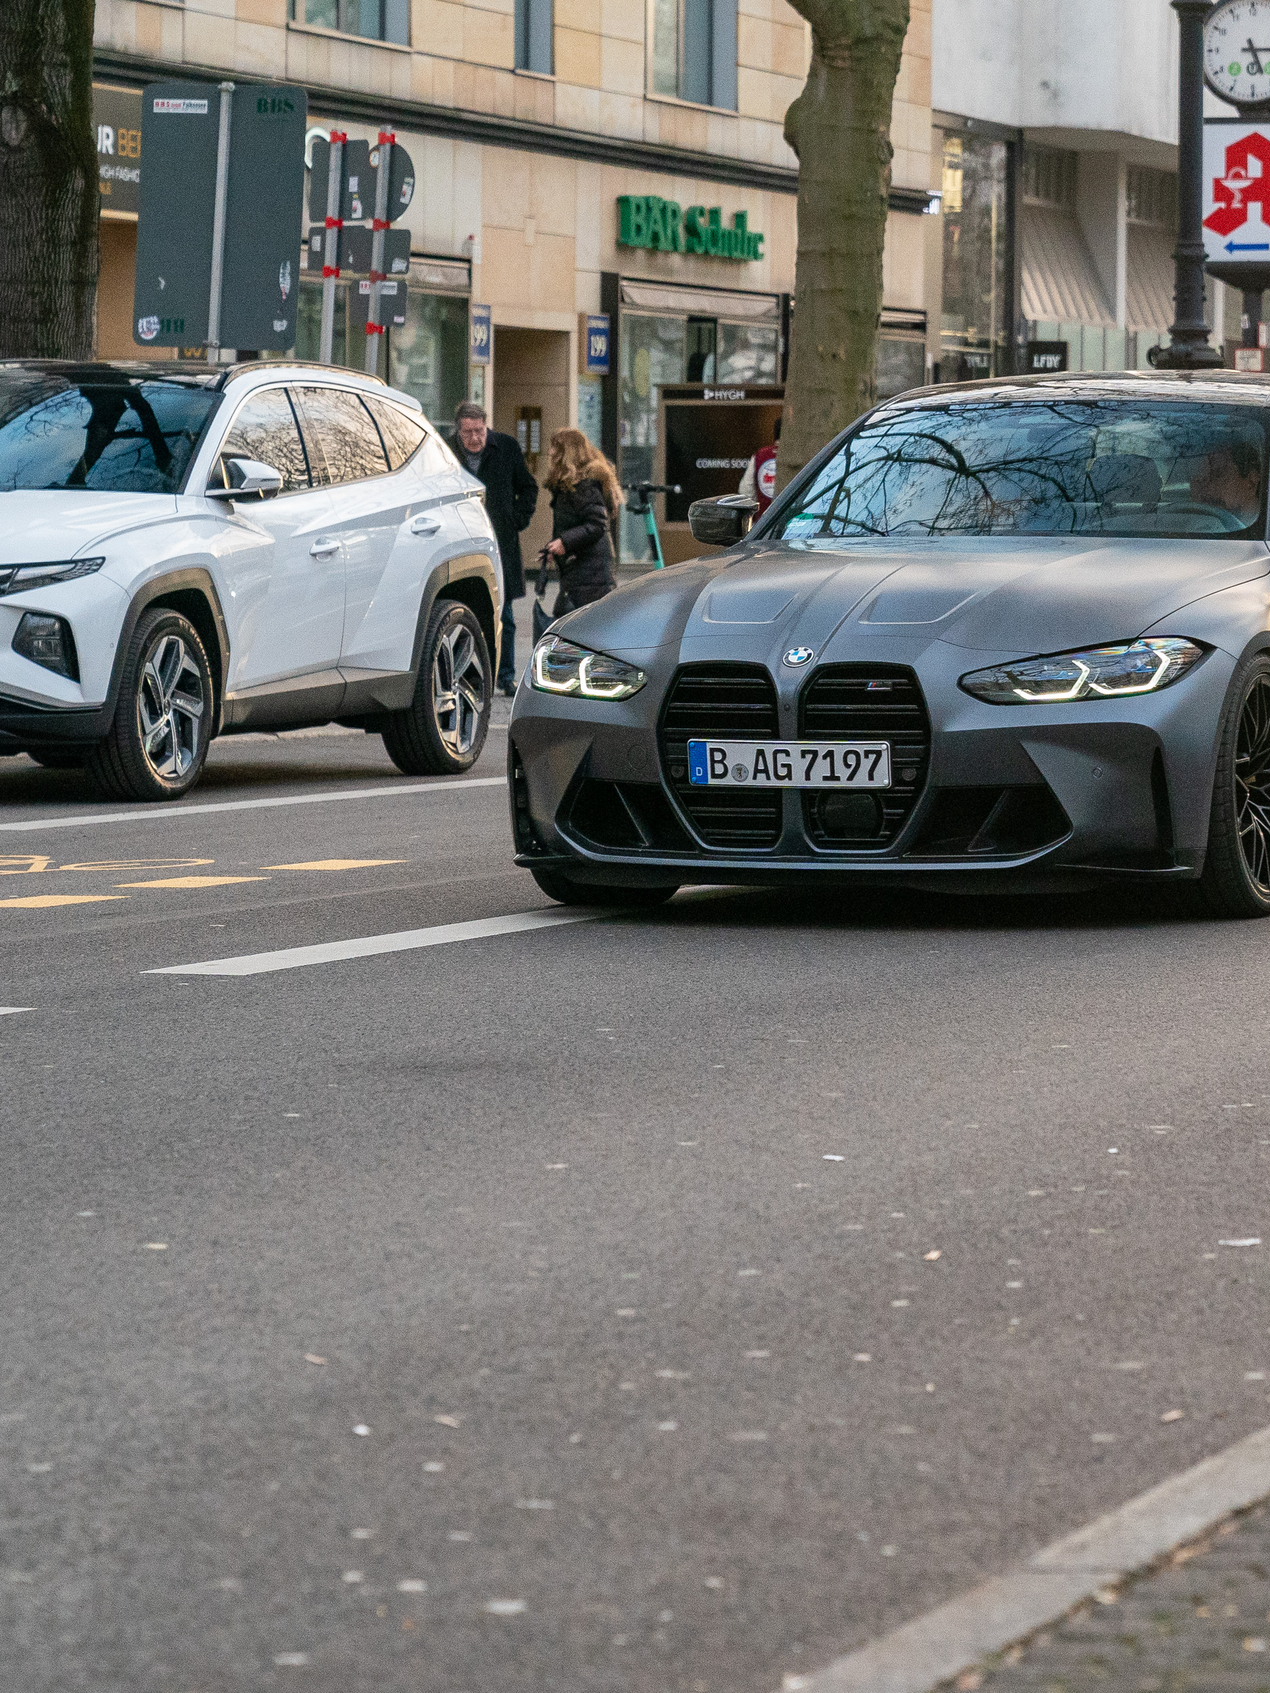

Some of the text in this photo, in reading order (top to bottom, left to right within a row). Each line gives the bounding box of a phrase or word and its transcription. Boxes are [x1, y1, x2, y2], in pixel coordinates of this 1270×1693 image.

[617, 195, 687, 253] BÄR
[590, 334, 607, 357] 199
[1032, 353, 1062, 368] LFDY
[715, 389, 745, 400] HYGH
[696, 458, 730, 469] COMING
[695, 747, 883, 782] D B AG 7197
